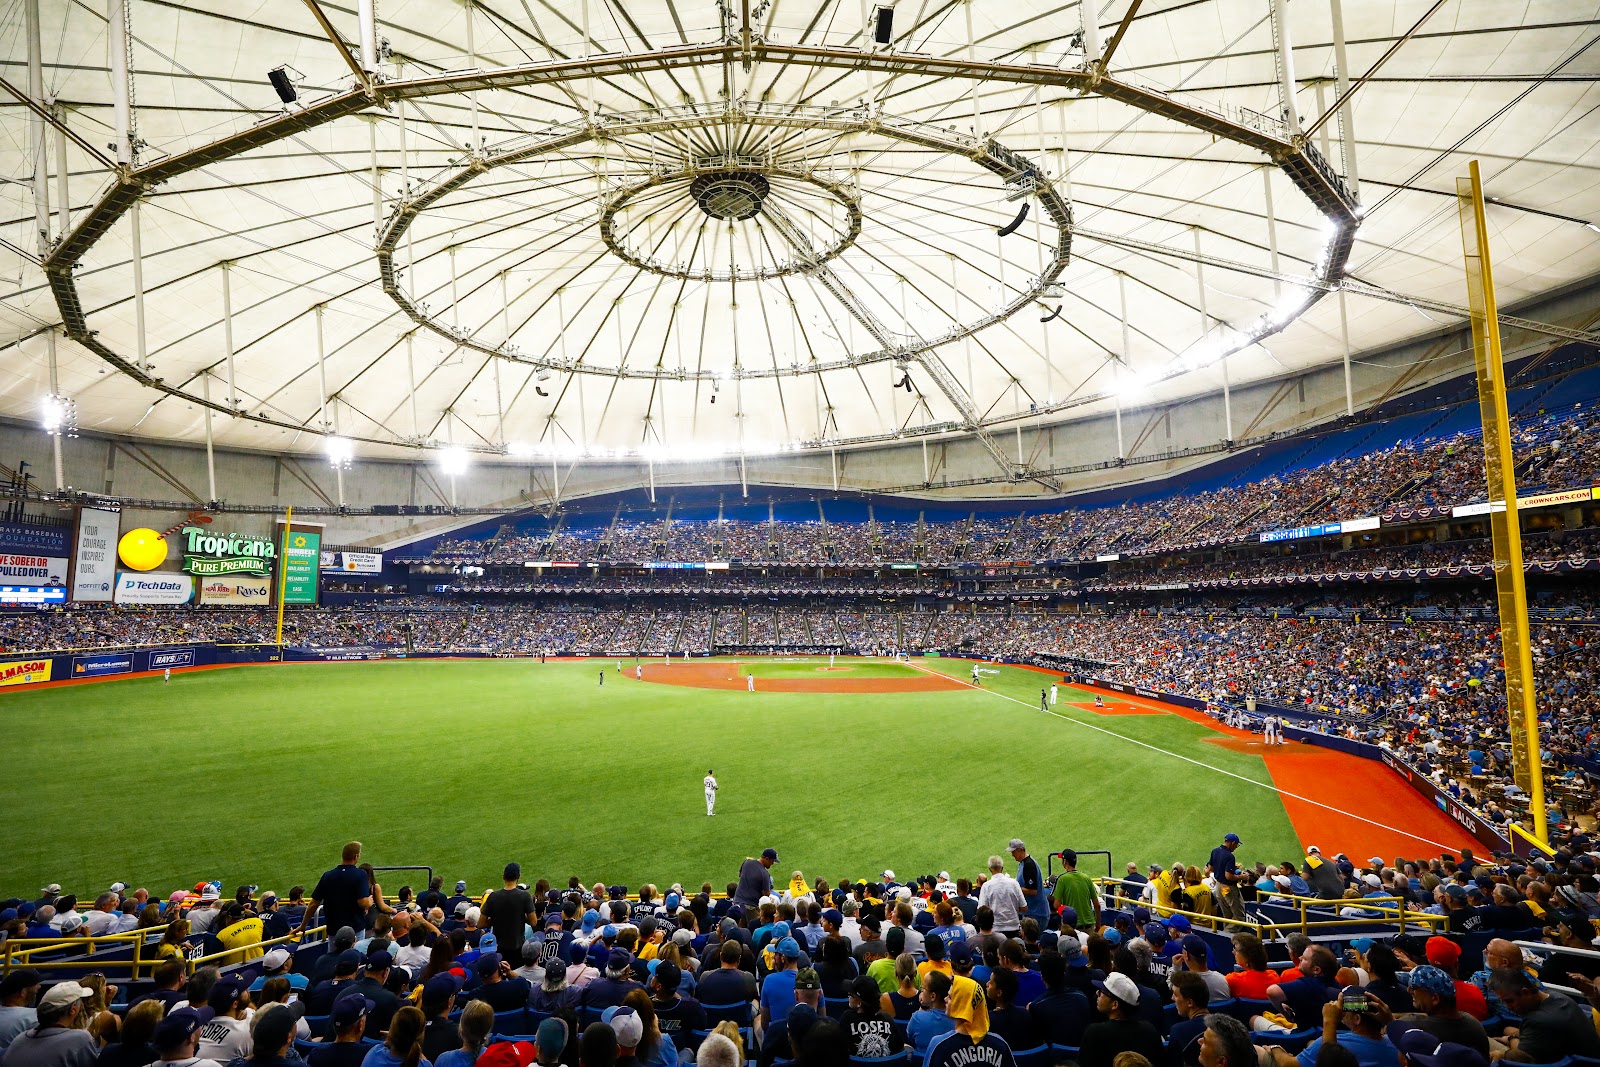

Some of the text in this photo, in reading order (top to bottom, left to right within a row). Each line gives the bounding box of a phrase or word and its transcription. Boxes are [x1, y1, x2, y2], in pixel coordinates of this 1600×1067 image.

[1524, 492, 1590, 506] CROWNCARS.COM
[0, 526, 64, 539] RAYS BASEBALL
[84, 525, 98, 536] YOUR
[82, 538, 107, 550] COURAGE
[182, 526, 275, 558] Tropicana
[10, 556, 36, 567] SOBER
[37, 557, 48, 567] OR
[81, 551, 105, 562] INSPIRES
[192, 560, 264, 572] PURE PREMIUM
[28, 567, 49, 578] OVER
[137, 581, 181, 590] Tech Data
[259, 586, 267, 596] 6
[1457, 810, 1477, 834] ALDS
[200, 1022, 231, 1045] GORIA
[850, 1020, 892, 1036] LOSER
